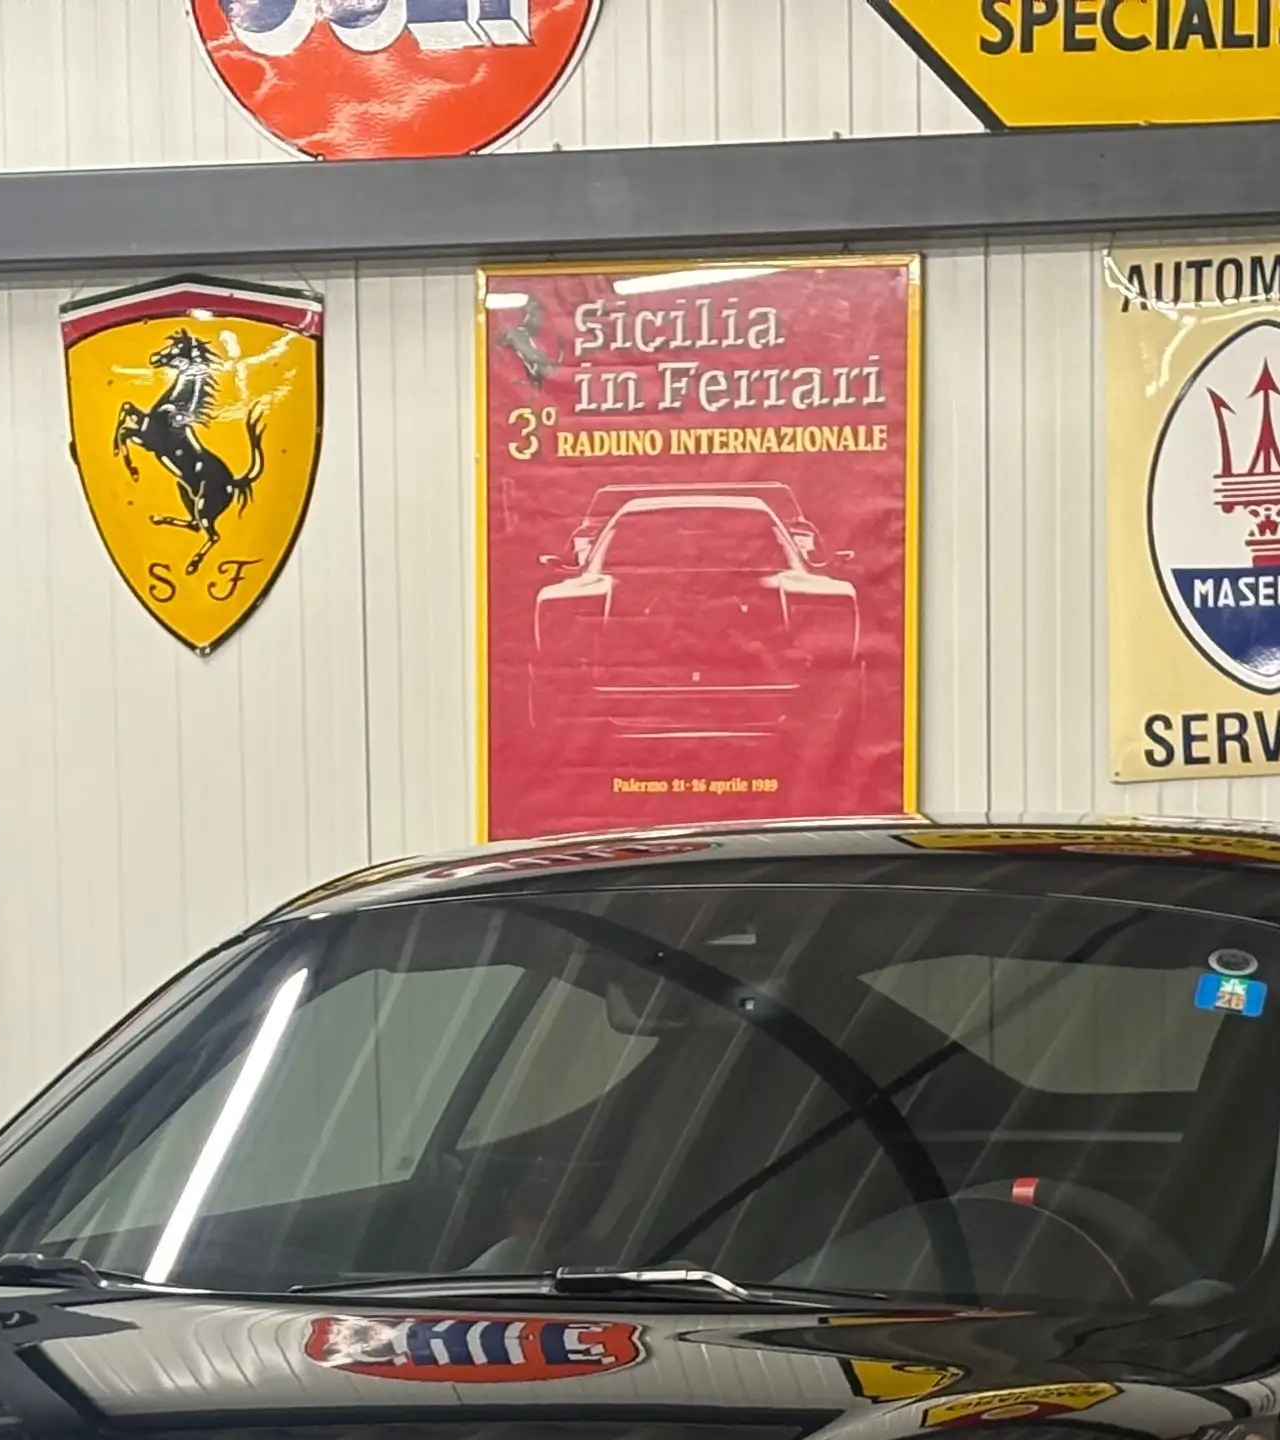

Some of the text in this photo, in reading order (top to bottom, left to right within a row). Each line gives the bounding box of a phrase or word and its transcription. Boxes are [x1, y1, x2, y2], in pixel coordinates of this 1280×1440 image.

[573, 298, 785, 357] Sicilia
[574, 355, 886, 413] in Ferrari
[557, 429, 663, 458] RADUNO
[670, 425, 888, 455] INTERNAZIONALE
[149, 562, 176, 603] S
[613, 777, 668, 793] Palermo
[709, 777, 748, 795] aprile
